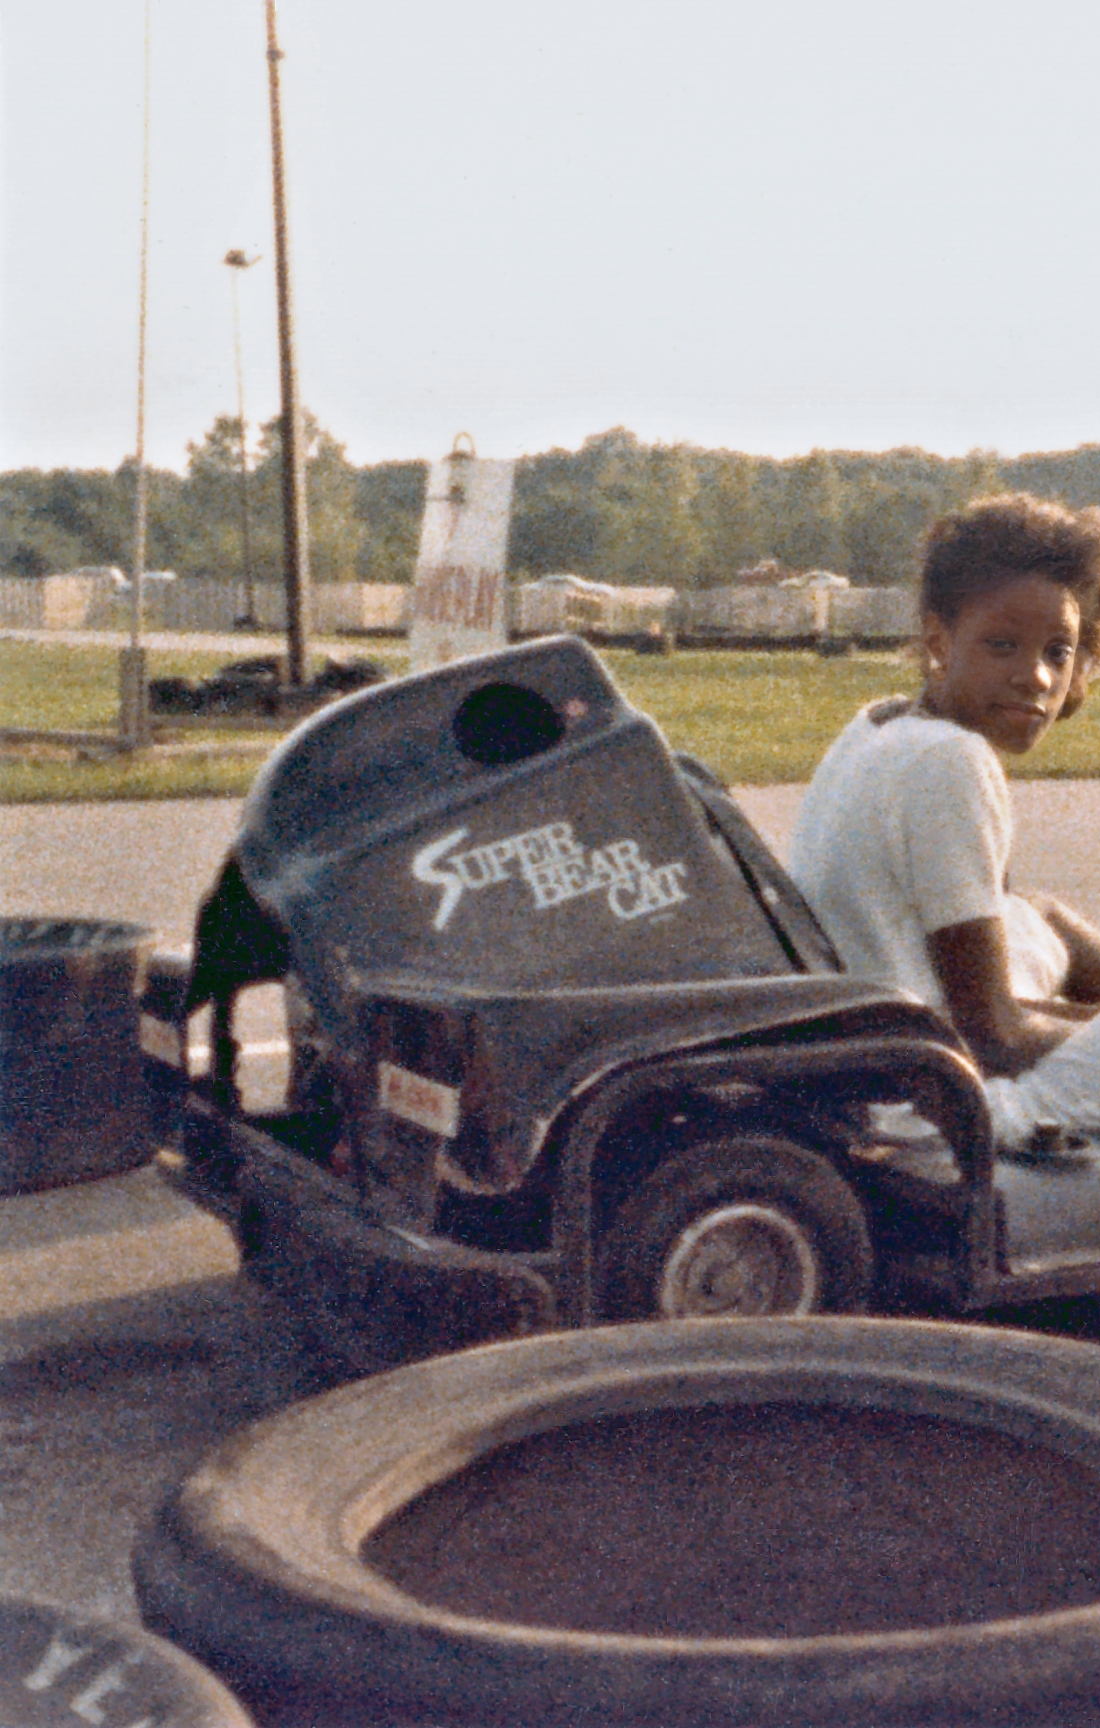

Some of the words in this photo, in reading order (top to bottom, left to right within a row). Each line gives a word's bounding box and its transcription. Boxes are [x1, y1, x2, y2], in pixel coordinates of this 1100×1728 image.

[411, 820, 584, 931] SUPER
[527, 838, 652, 909] BEAR
[607, 862, 691, 921] CAT
